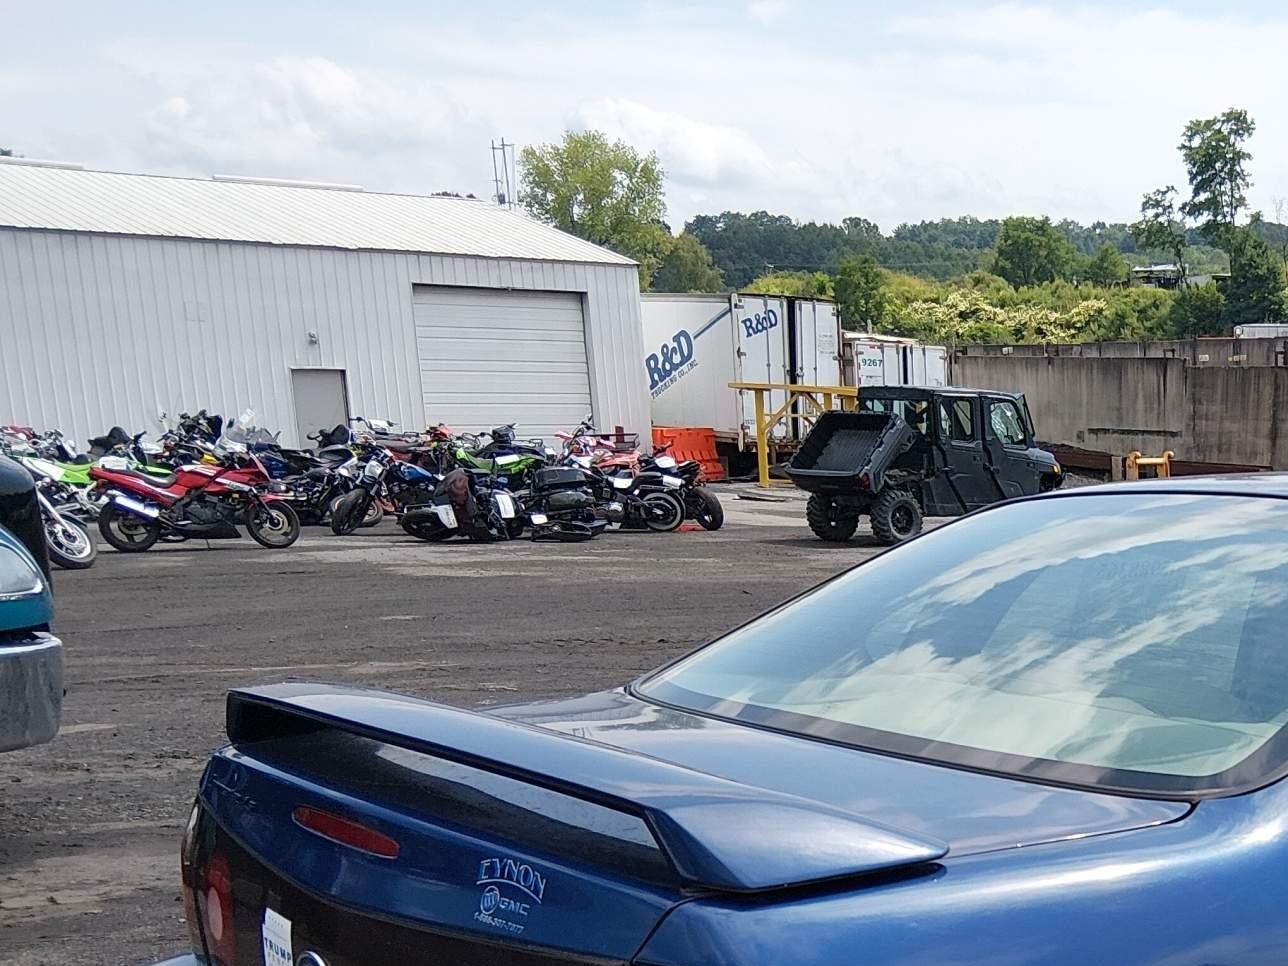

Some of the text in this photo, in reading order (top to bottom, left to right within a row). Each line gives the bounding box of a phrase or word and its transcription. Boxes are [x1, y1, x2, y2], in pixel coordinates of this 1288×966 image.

[741, 309, 778, 338] R&D
[645, 330, 693, 390] R&D
[861, 359, 883, 367] 9267
[480, 858, 546, 899] EYNON
[500, 897, 530, 916] GMC
[264, 937, 292, 961] TRUMP
